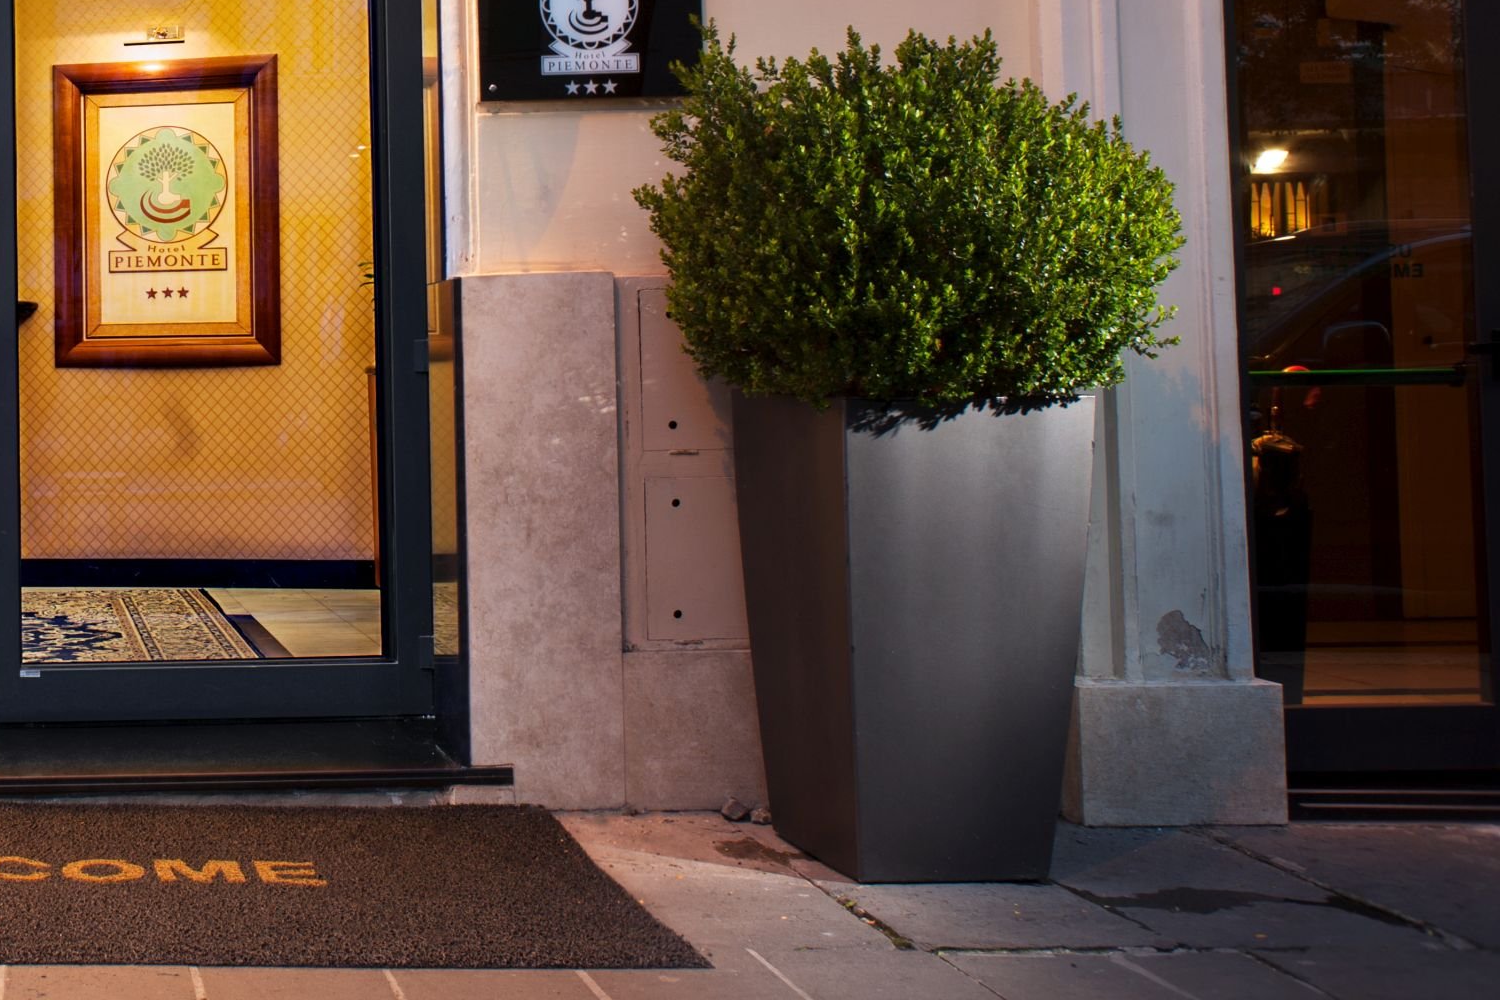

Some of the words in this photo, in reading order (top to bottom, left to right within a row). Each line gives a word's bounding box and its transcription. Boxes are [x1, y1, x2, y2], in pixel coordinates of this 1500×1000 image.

[574, 51, 606, 60] Hotel
[548, 59, 633, 71] PIEMONTE
[147, 244, 186, 253] Hotel
[114, 254, 221, 268] PIEMONTE
